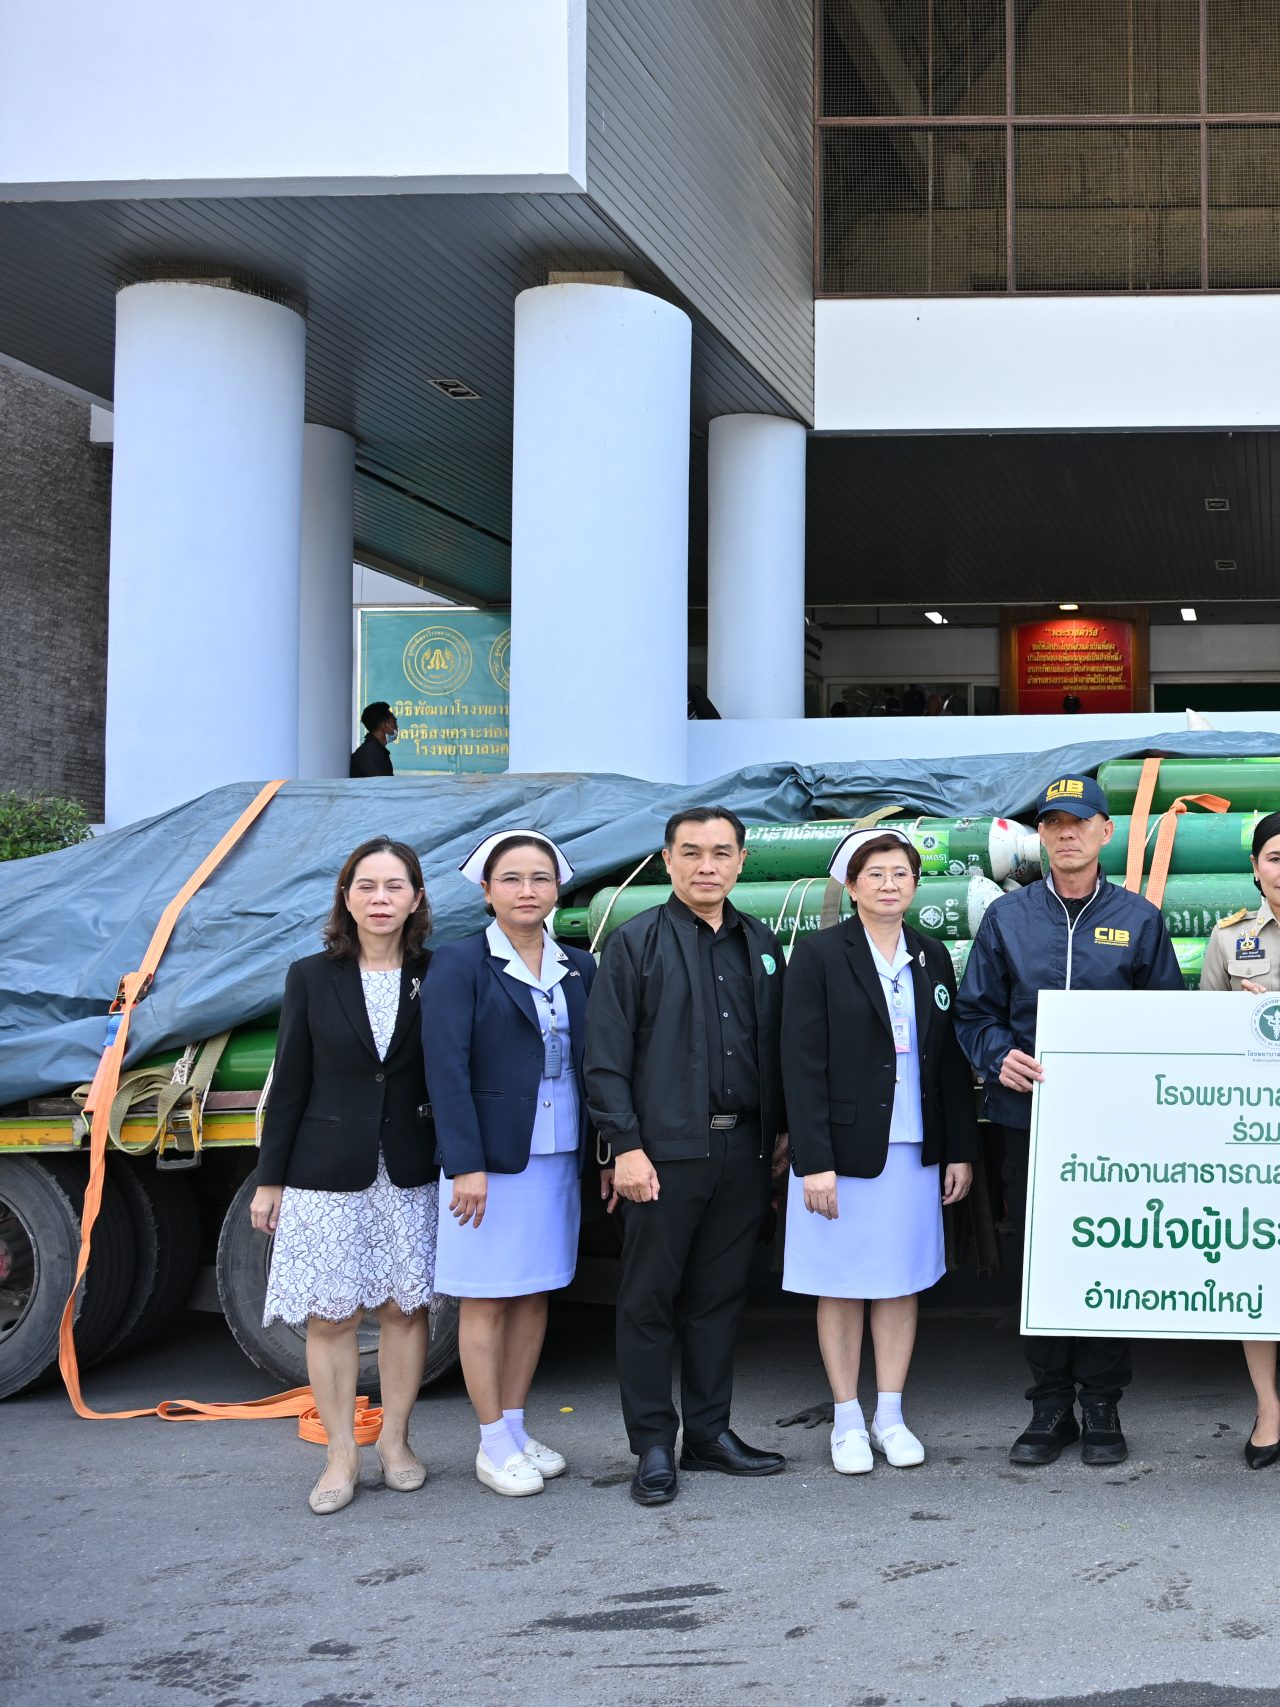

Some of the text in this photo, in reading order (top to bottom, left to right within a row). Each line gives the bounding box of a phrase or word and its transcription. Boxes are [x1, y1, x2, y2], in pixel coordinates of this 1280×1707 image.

[1047, 779, 1084, 795] CIB
[1094, 927, 1130, 942] CIB
[1085, 1280, 1263, 1319] อำเภอหาดใหญ่
